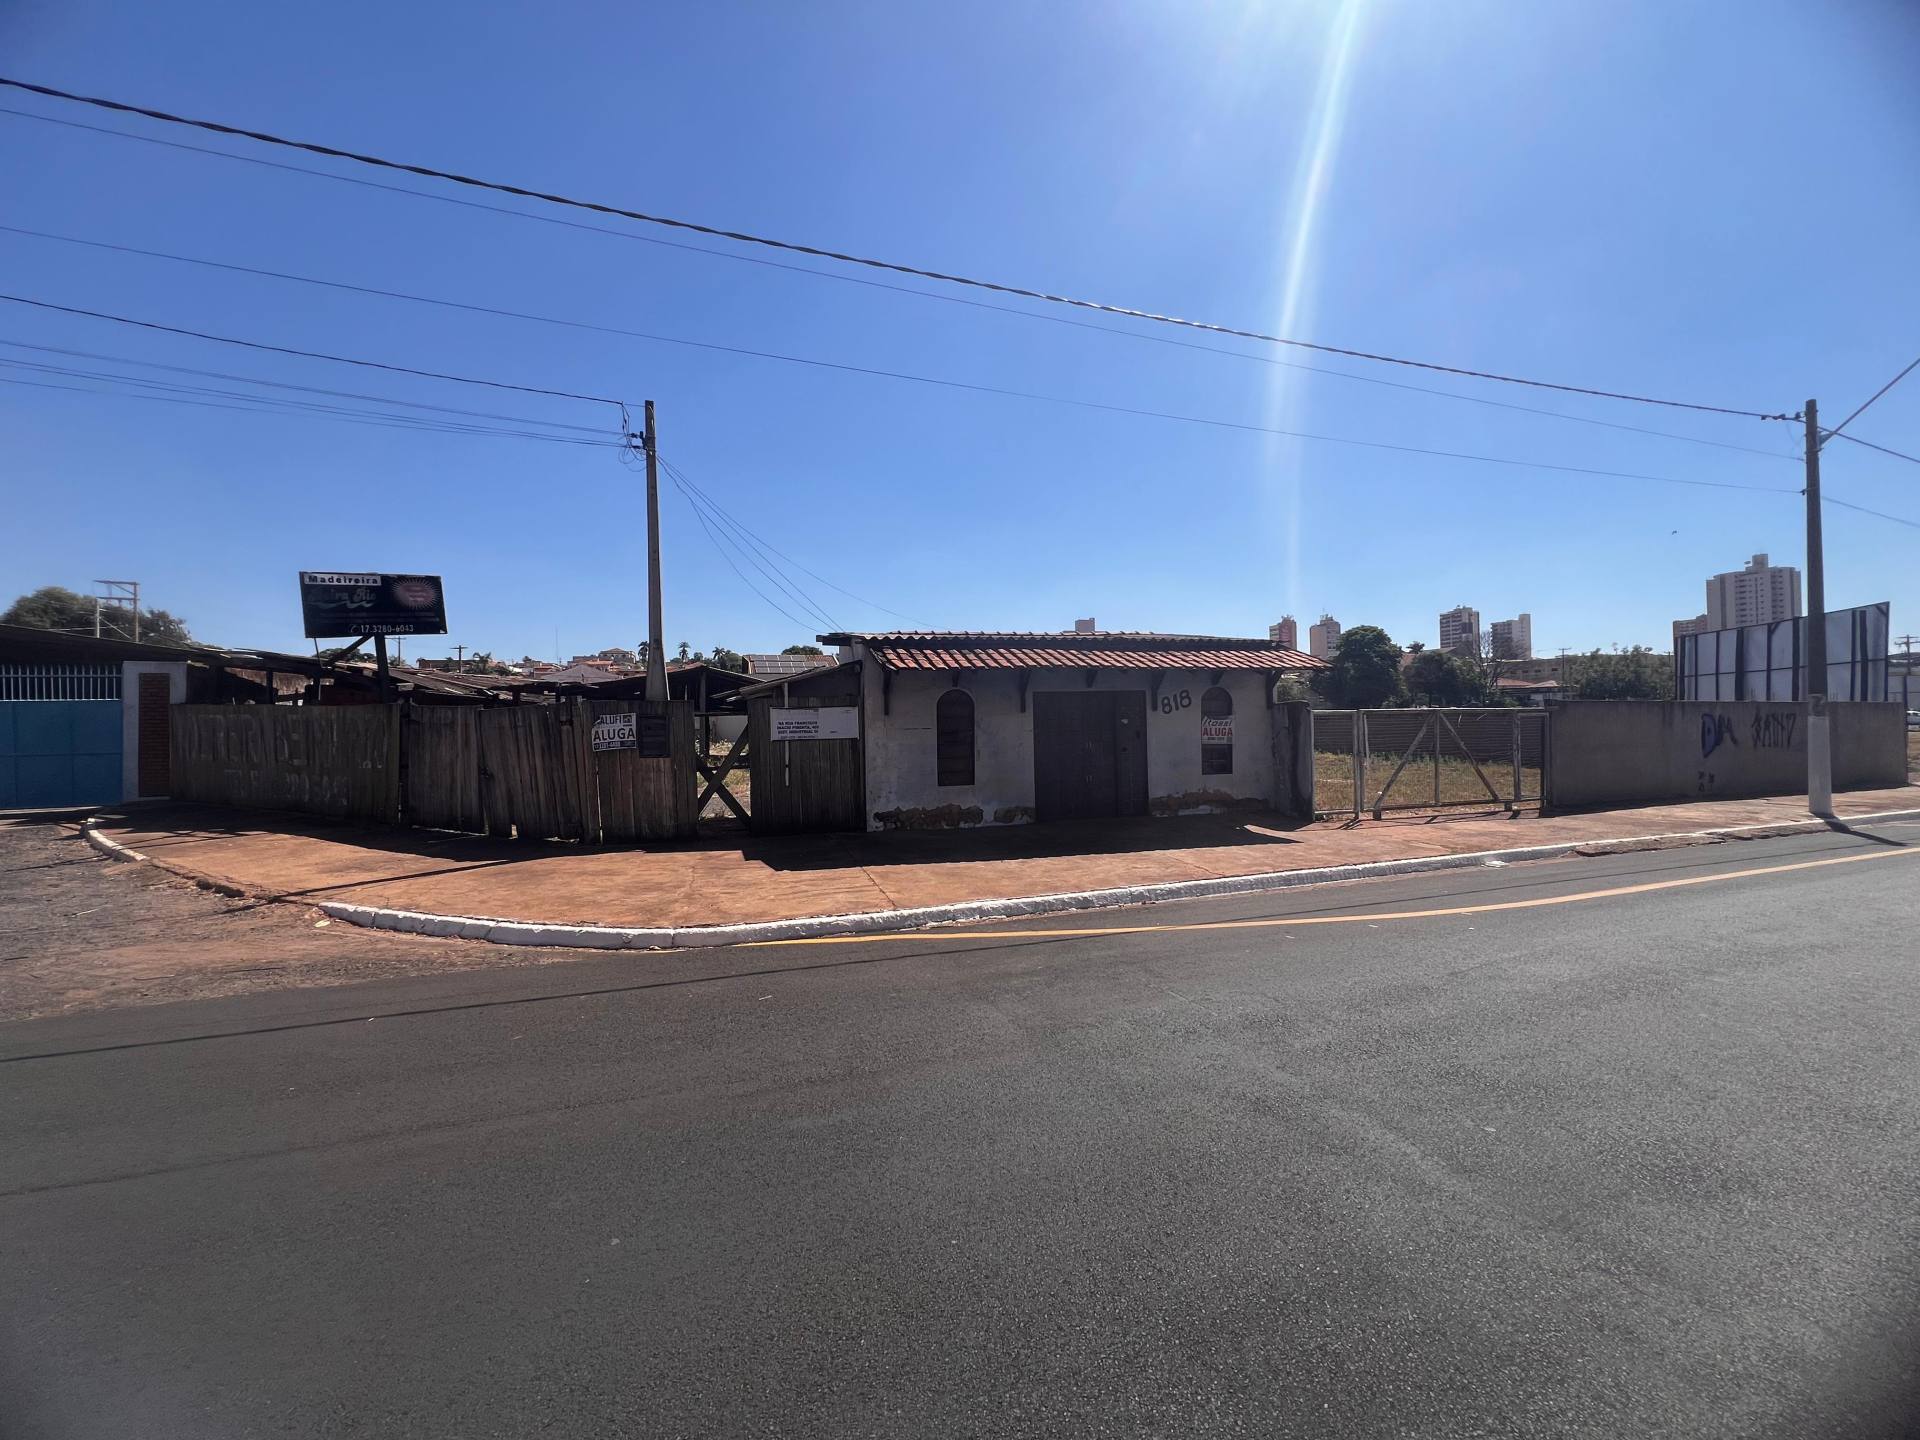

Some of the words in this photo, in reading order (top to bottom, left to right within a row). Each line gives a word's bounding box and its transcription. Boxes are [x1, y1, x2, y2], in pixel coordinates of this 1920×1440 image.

[308, 575, 379, 585] Madeireira
[1161, 689, 1192, 714] 818
[593, 728, 636, 741] ALUGA
[1202, 728, 1233, 737] ALUGA
